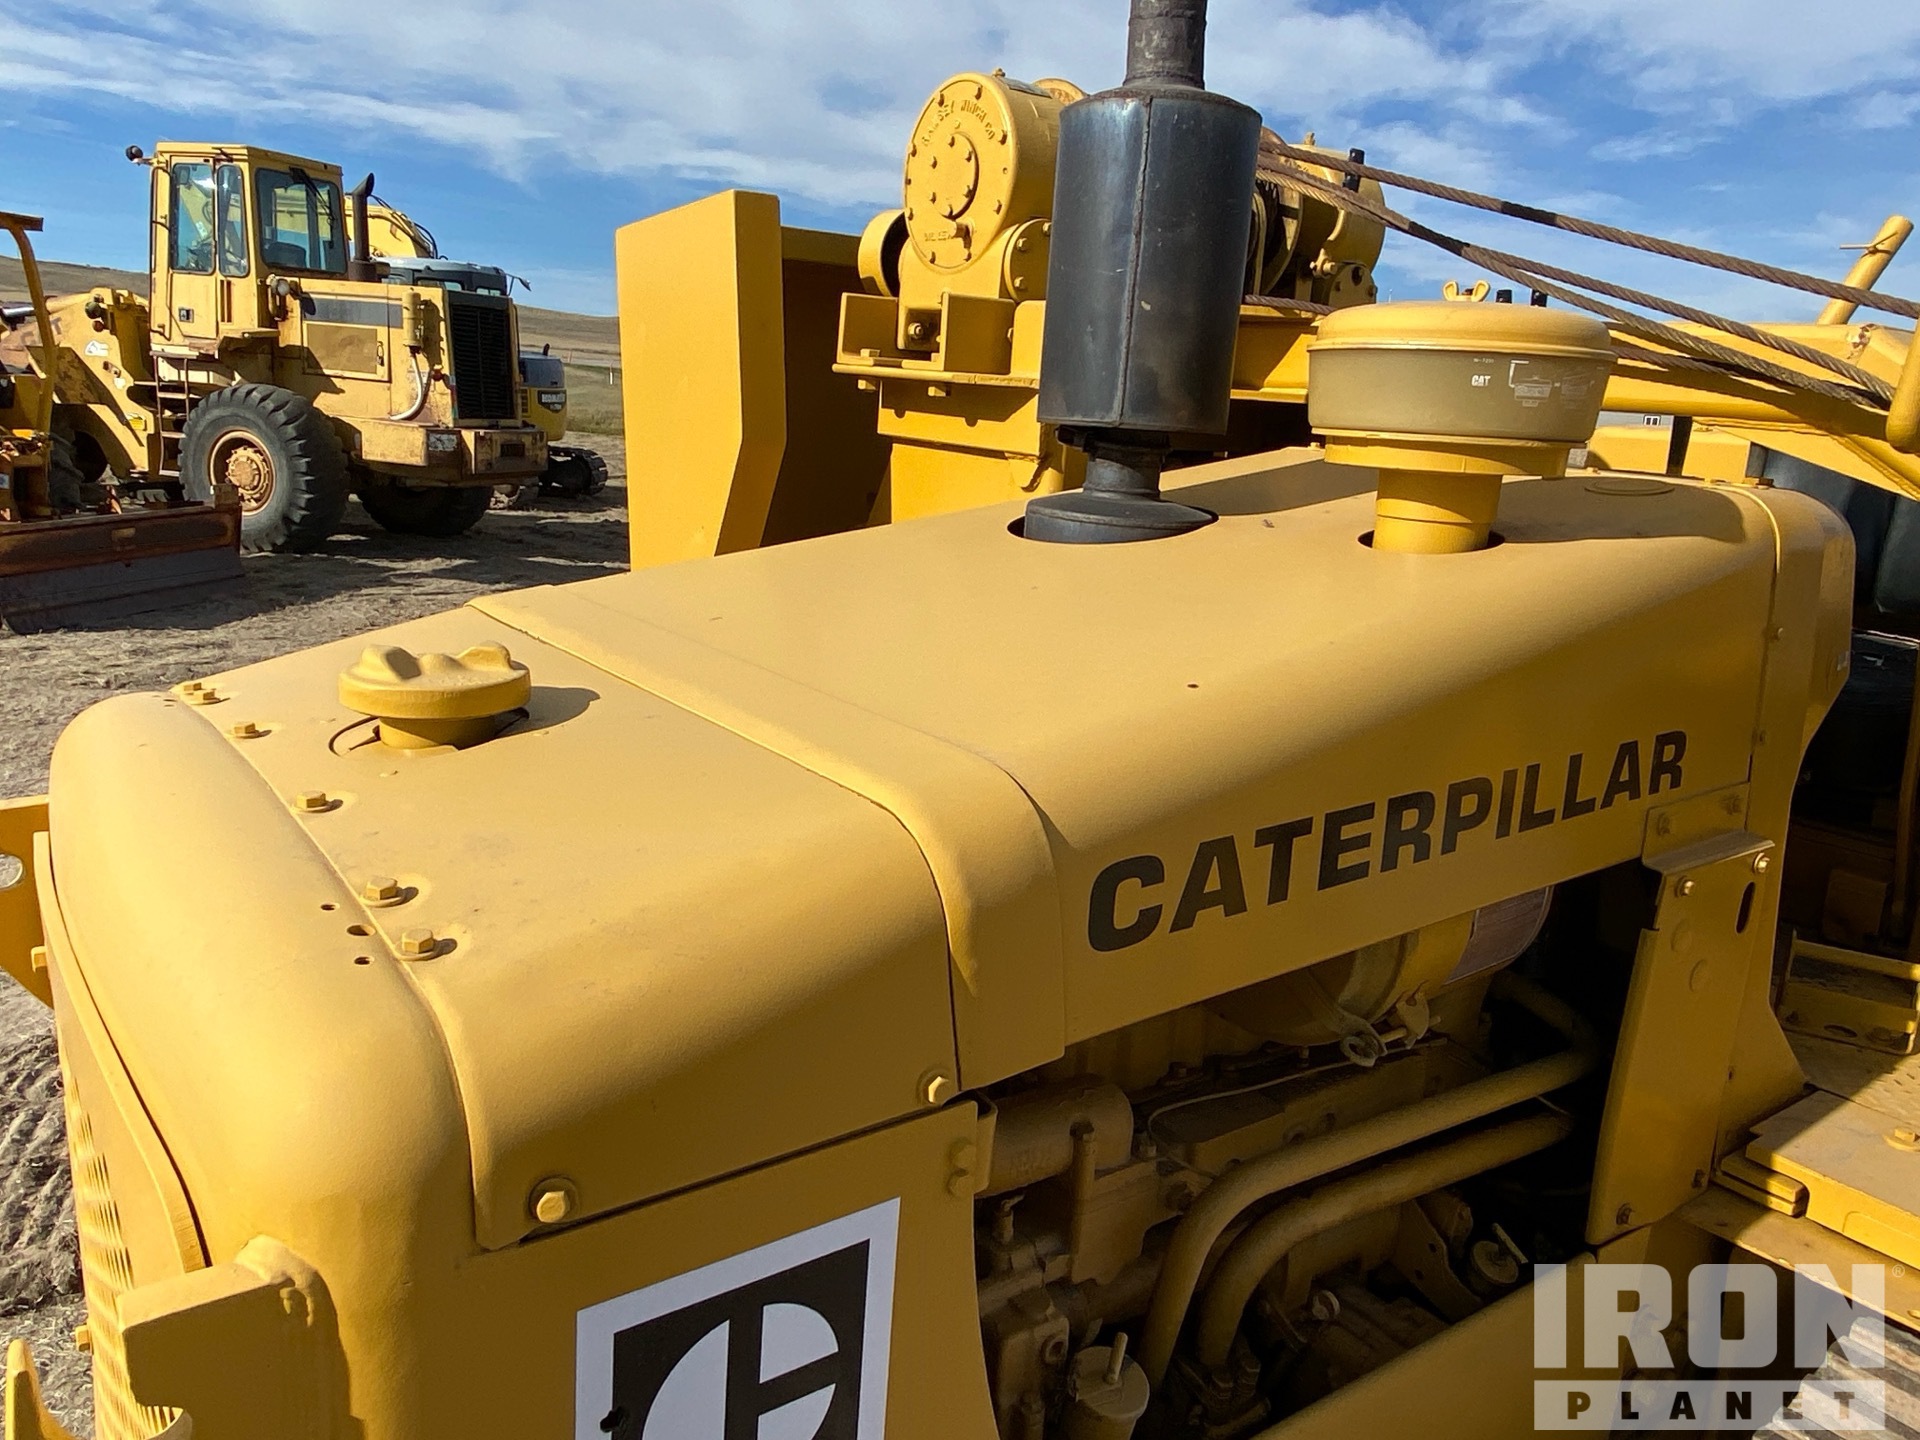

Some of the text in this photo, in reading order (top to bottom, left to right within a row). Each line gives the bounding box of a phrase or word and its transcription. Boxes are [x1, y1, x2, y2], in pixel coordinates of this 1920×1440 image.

[20, 316, 62, 346] CT
[1471, 374, 1492, 387] CAT
[1086, 729, 1688, 953] CATERPILLAR
